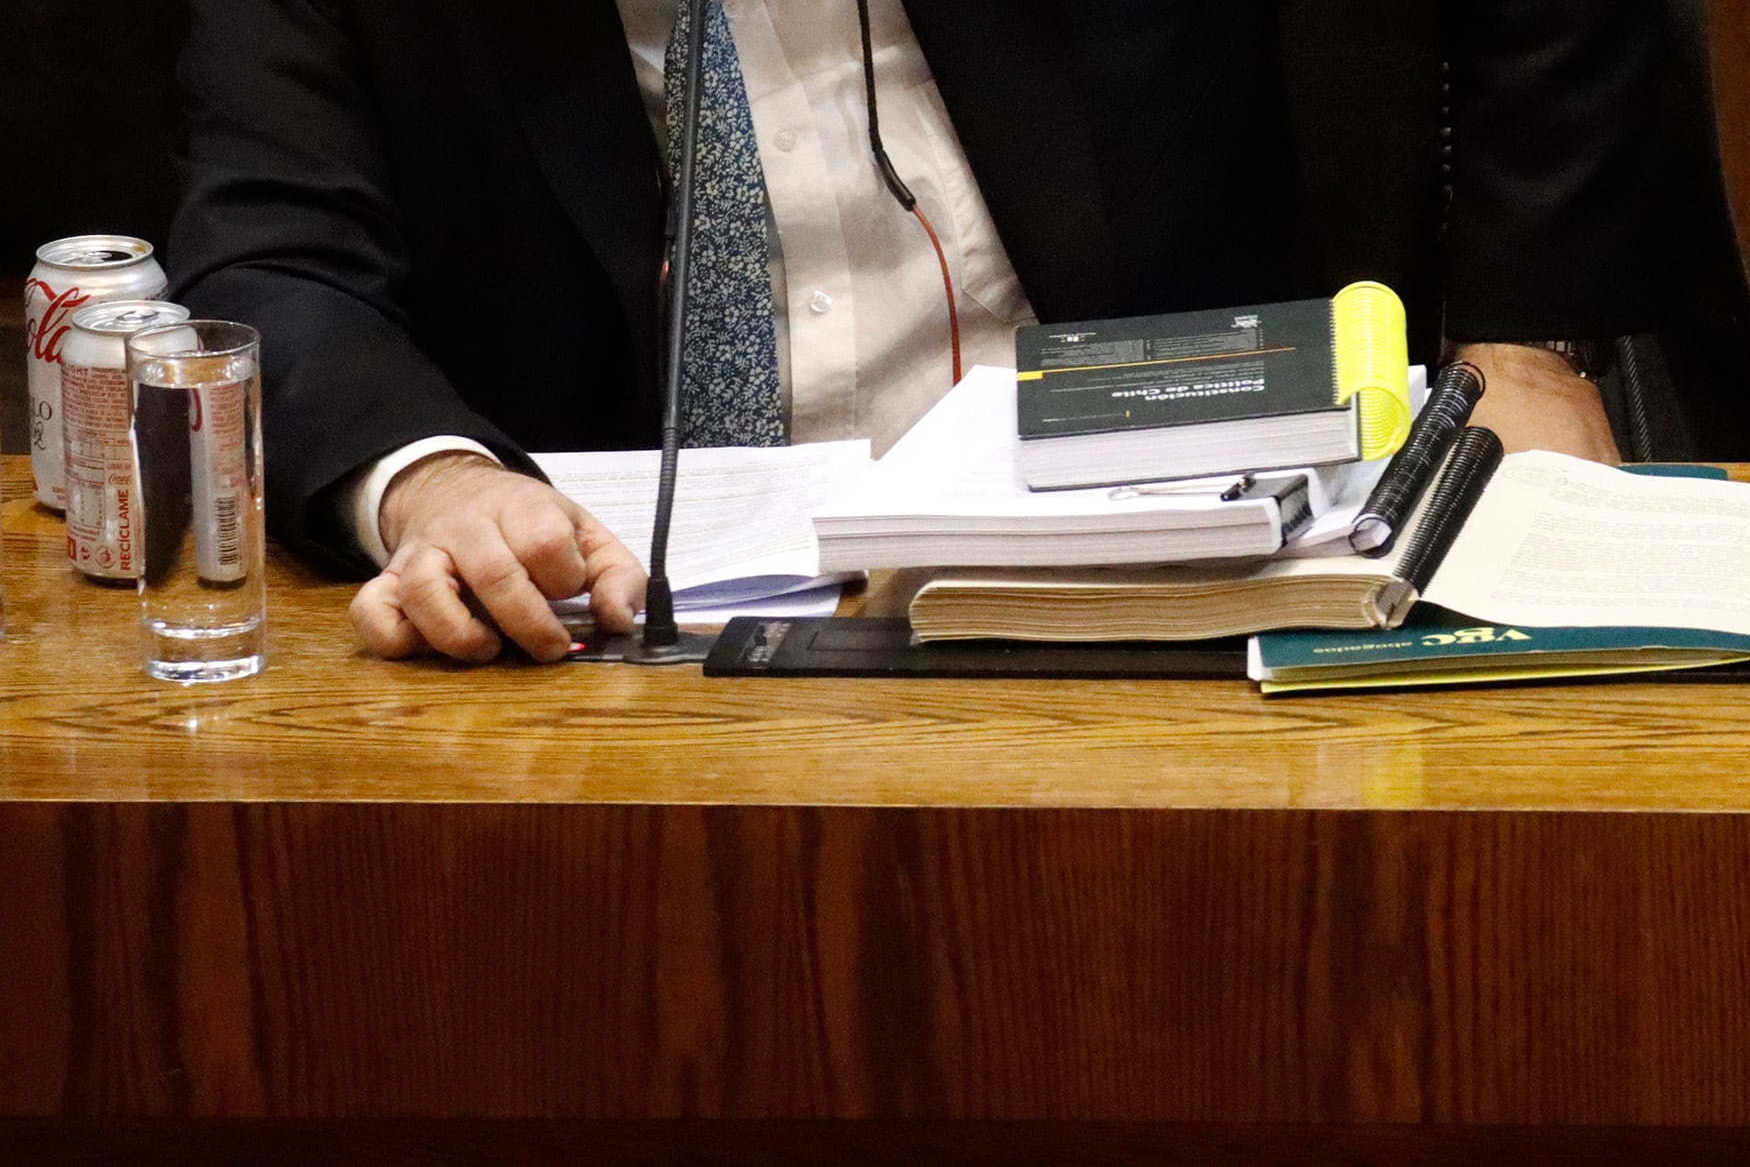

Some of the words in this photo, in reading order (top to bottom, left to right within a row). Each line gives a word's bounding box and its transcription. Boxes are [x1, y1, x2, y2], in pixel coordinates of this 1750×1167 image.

[25, 278, 92, 365] ola
[1111, 388, 1161, 397] Chile
[1144, 384, 1265, 401] Constitución
[1165, 385, 1190, 393] de
[117, 489, 132, 570] RECÍCLAME
[1313, 641, 1413, 654] abogados
